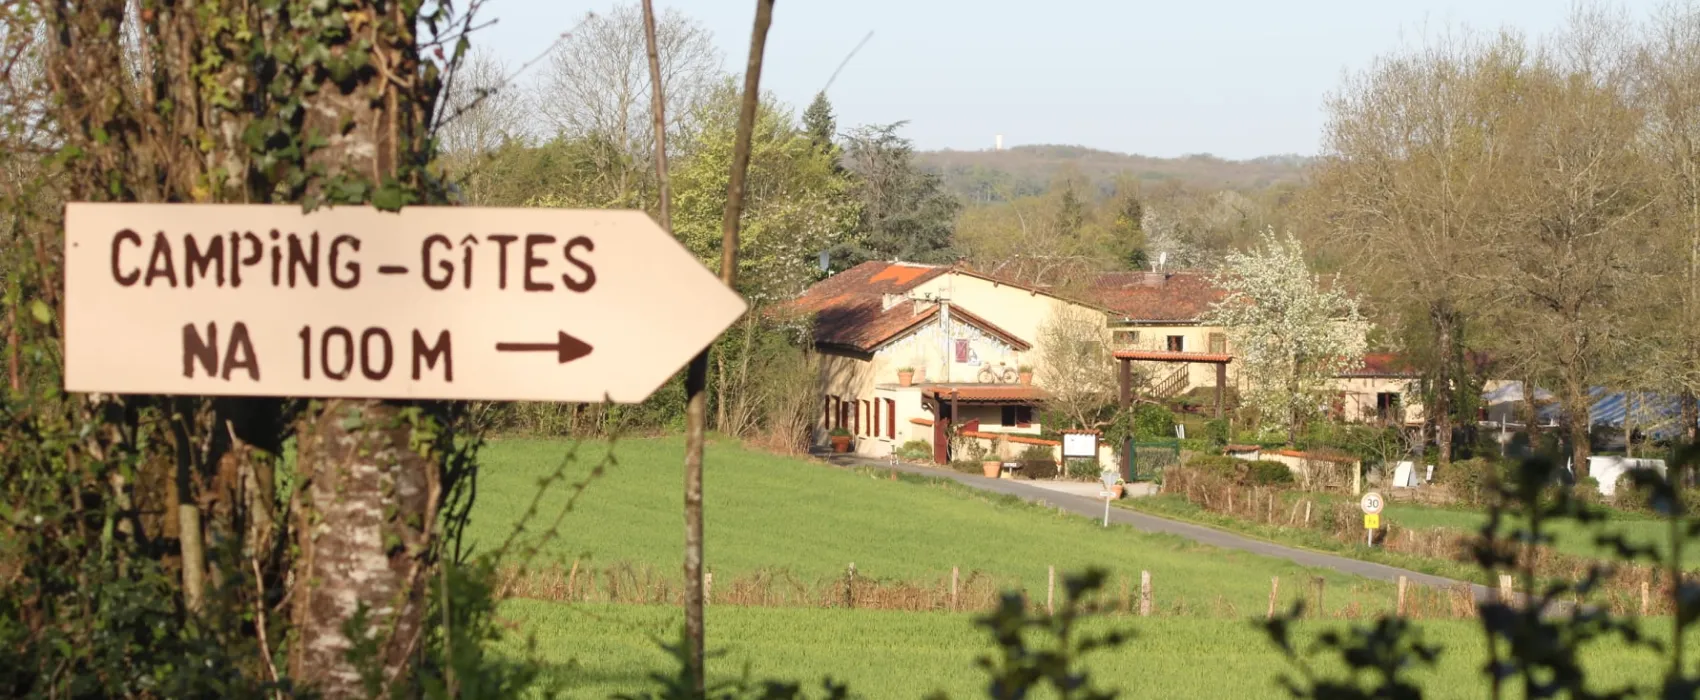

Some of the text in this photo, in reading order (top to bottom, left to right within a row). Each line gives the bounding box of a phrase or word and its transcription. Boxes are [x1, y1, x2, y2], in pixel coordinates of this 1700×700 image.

[182, 321, 454, 383] NA 100 M
[1367, 499, 1379, 508] 30
